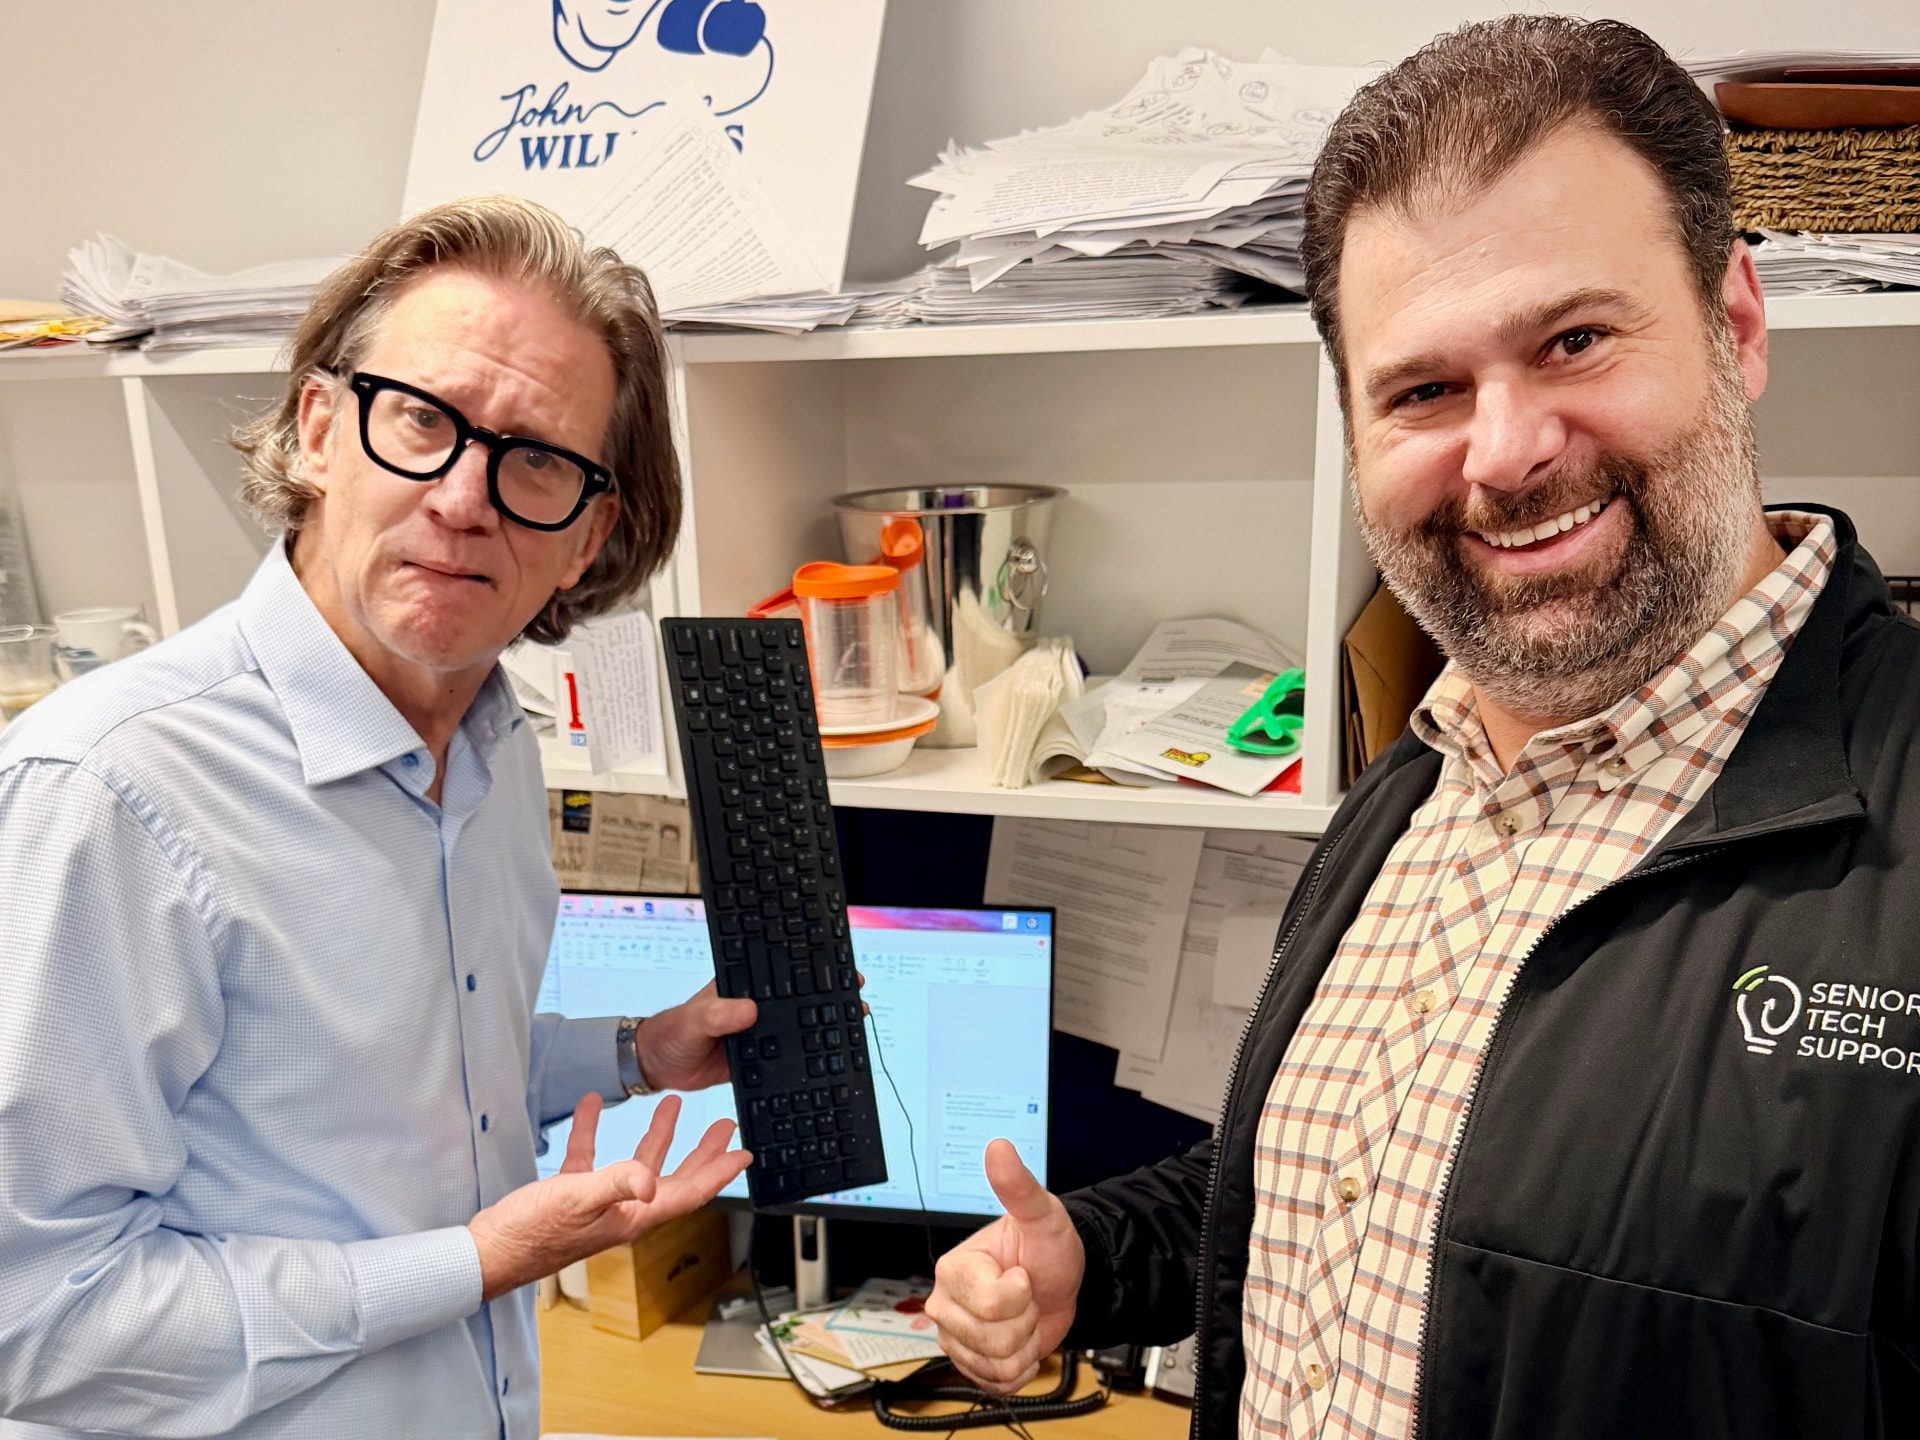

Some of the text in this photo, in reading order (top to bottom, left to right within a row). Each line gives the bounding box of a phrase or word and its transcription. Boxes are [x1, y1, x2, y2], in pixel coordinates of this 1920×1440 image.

[474, 81, 591, 161] John
[1809, 983, 1920, 1017] SENIOR
[1807, 1009, 1886, 1038] TECH
[1796, 1036, 1920, 1075] SUPPOR
